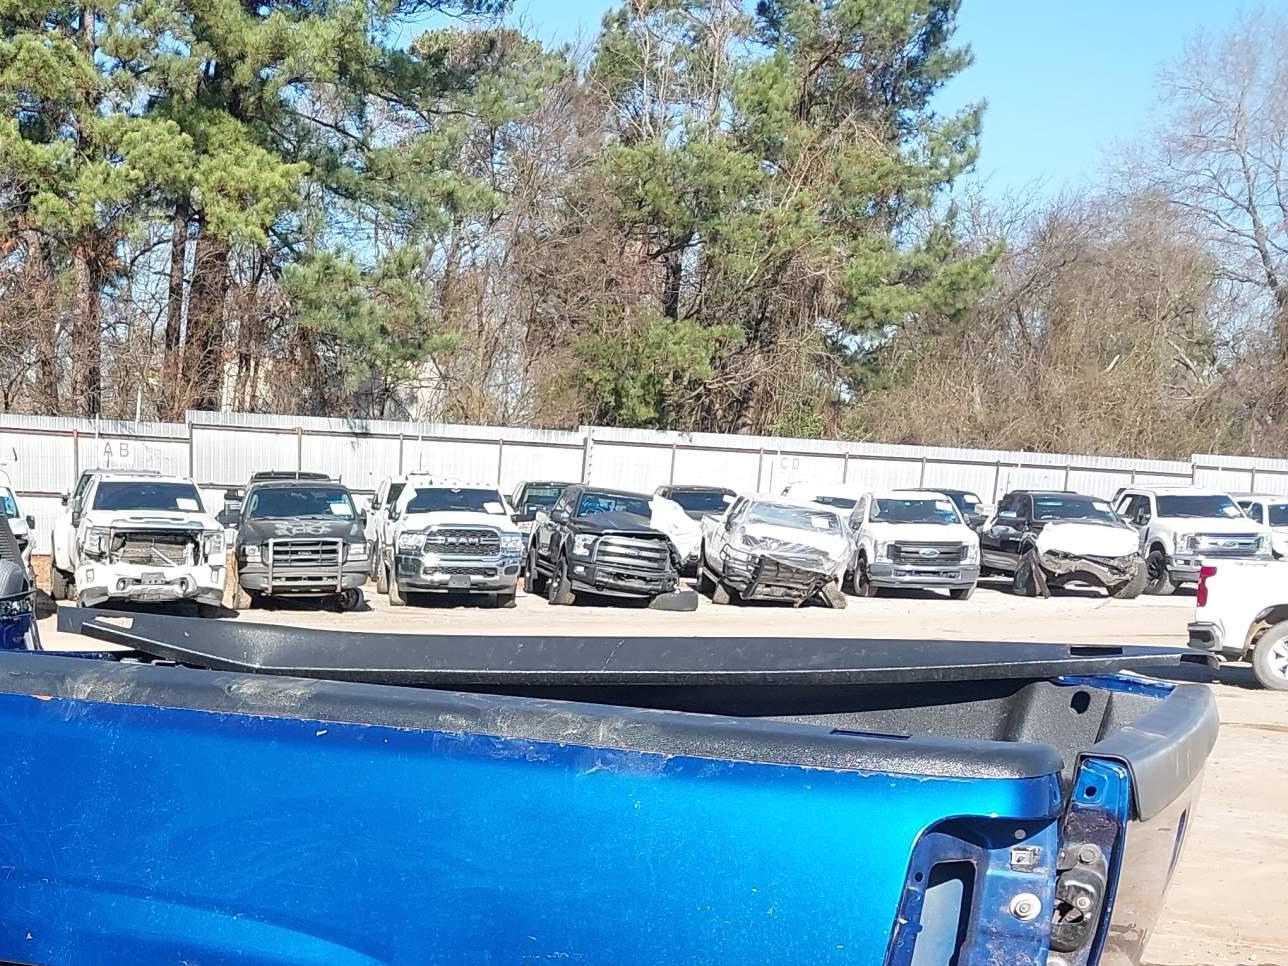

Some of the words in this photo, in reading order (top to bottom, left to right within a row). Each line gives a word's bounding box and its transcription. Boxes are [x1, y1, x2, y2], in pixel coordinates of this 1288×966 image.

[103, 441, 113, 457] A
[120, 443, 130, 457] B
[447, 536, 479, 545] RAM
